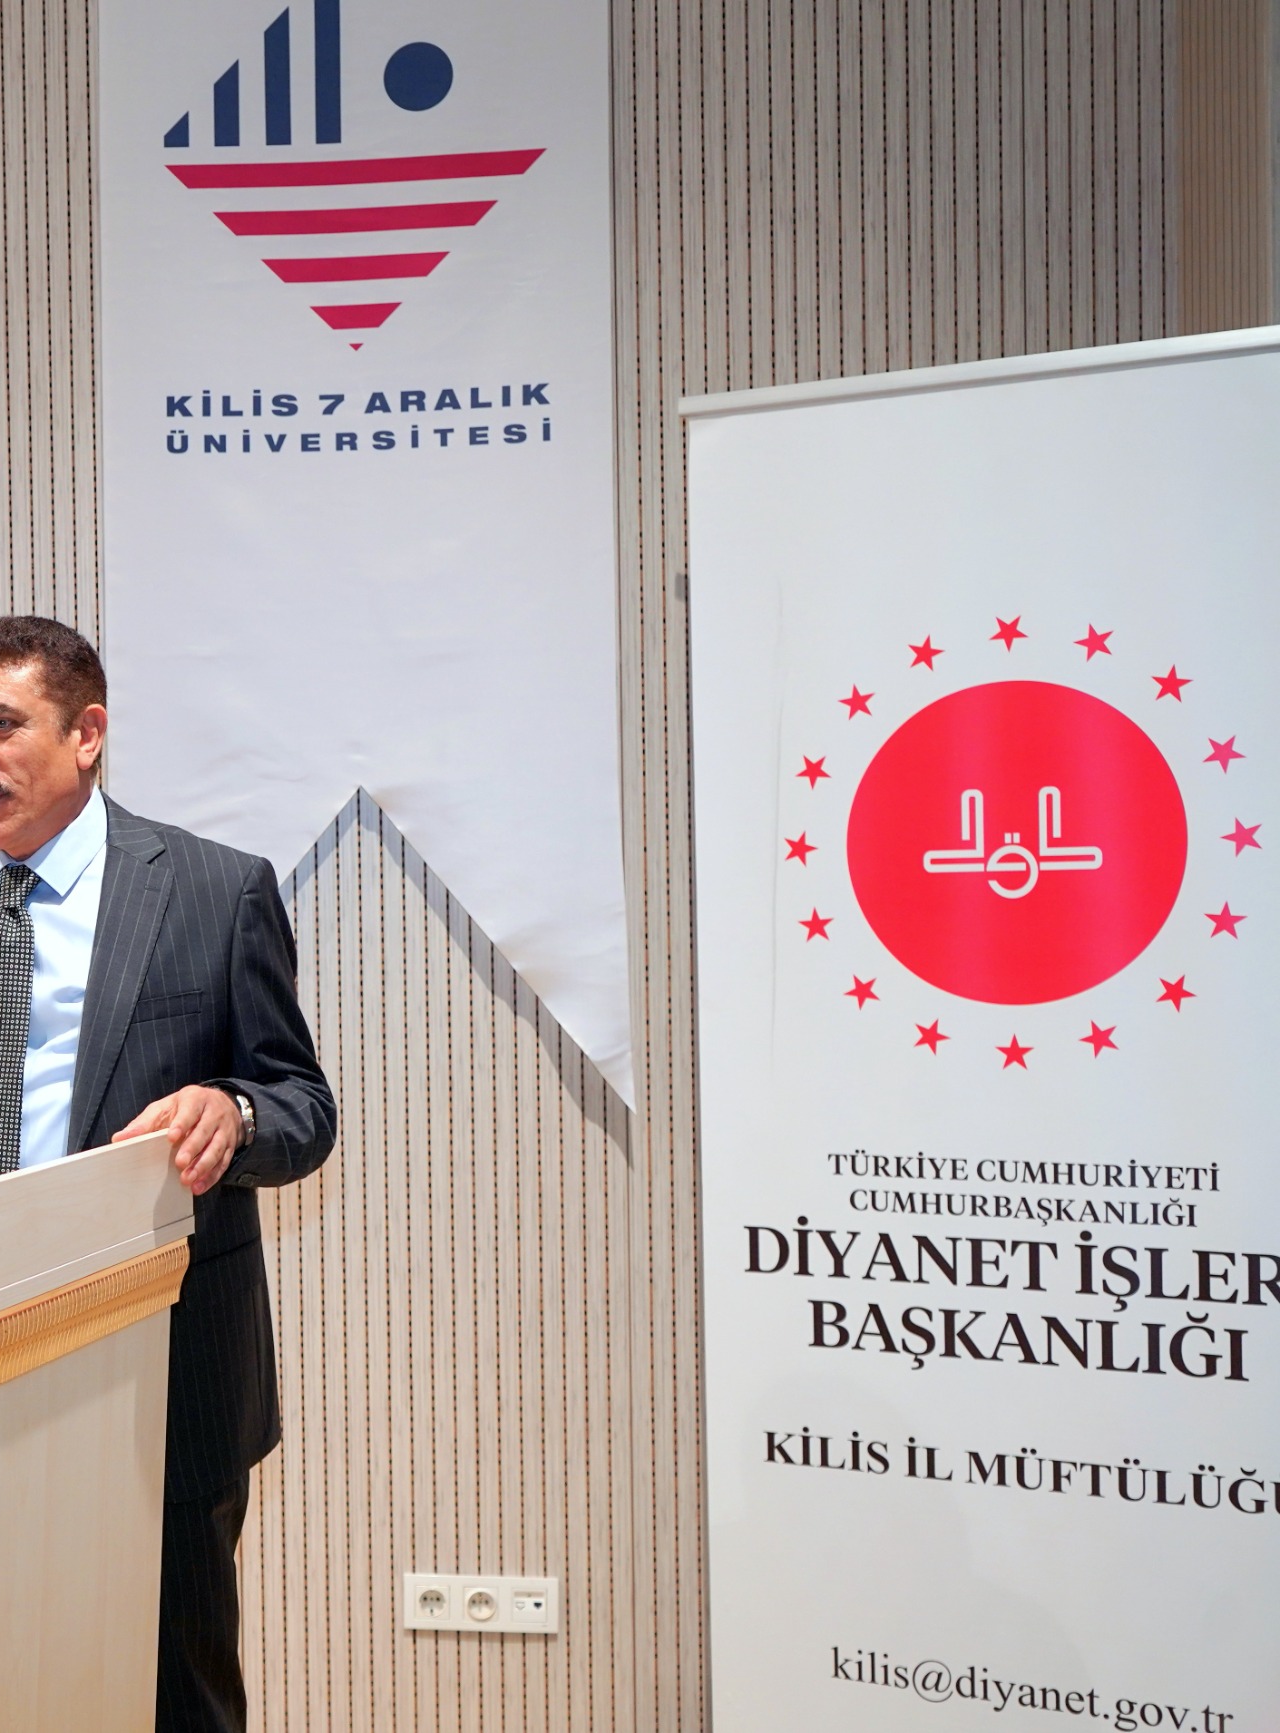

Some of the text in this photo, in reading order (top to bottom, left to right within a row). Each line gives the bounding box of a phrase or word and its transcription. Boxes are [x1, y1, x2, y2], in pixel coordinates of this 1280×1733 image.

[166, 383, 550, 417] KİLİS 7 ARALIK
[166, 418, 551, 454] ÜNİVERSİTESİ
[827, 1150, 1221, 1192] TÜRKİYE CUMHURİYETİ
[849, 1189, 1198, 1228] CUMHURBAŞKANLIĞI
[743, 1215, 1058, 1292] DİYANET
[808, 1299, 1250, 1382] BAŞKANLIĞI
[763, 1426, 891, 1475] KİLİS
[904, 1437, 953, 1482] İL
[830, 1644, 1236, 1733] kilis@diyanet.gov.tr
